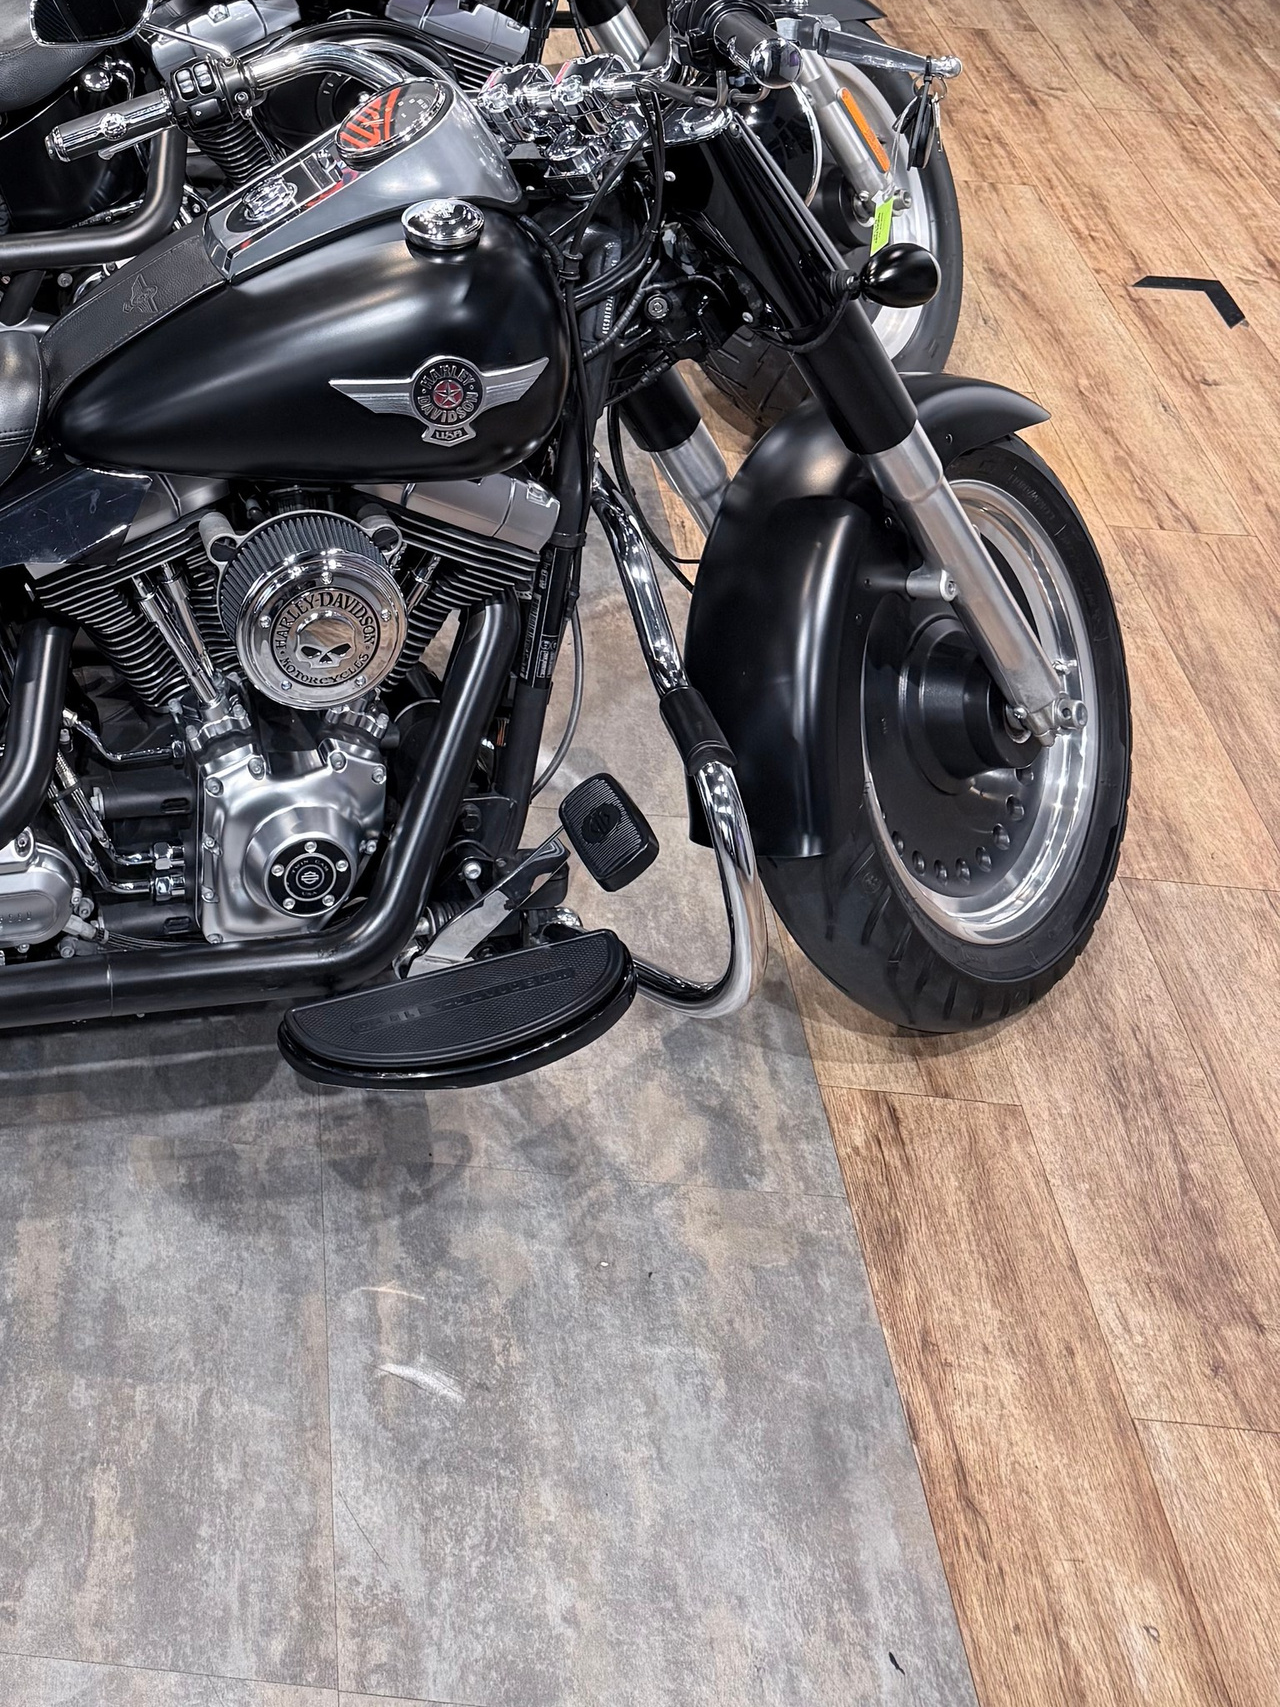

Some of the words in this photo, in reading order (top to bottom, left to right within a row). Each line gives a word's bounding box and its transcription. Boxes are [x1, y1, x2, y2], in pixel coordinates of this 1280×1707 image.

[420, 364, 476, 390] HARLEY
[417, 391, 479, 423] DAVIDSON
[275, 592, 376, 649] HARLEY-DAVIDSON
[280, 653, 369, 684] MOTORCYCLES
